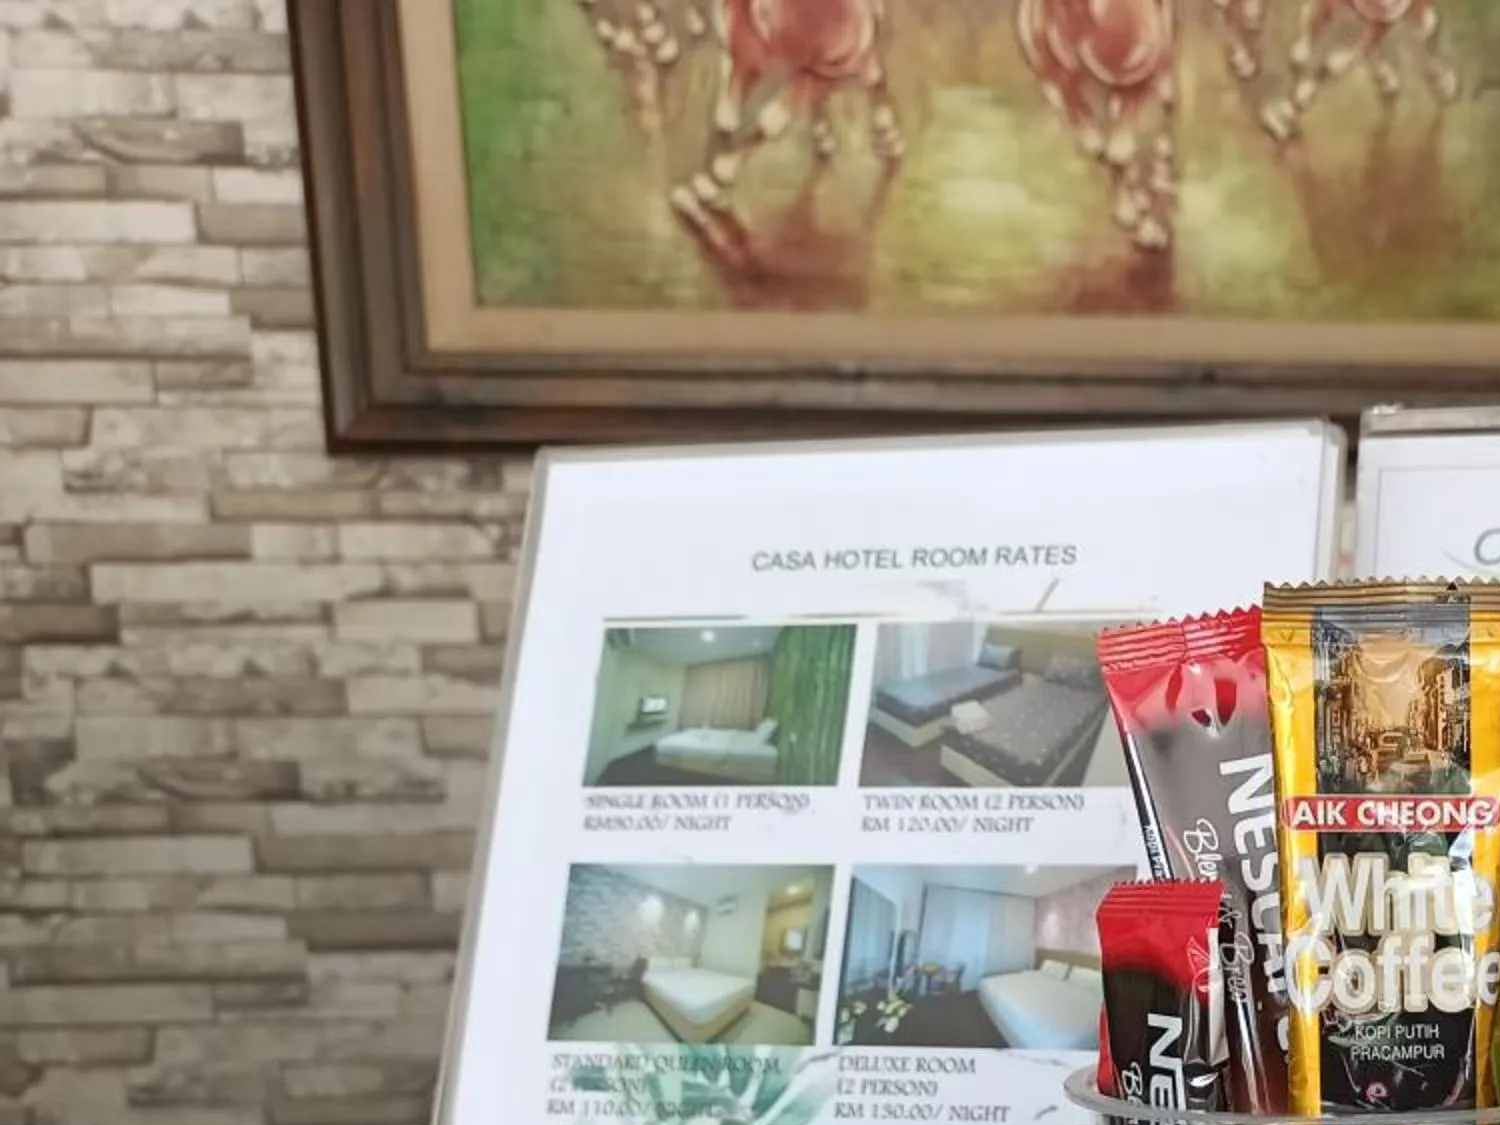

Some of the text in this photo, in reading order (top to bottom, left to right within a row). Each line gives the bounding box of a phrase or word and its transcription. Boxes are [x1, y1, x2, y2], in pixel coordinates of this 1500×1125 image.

[751, 545, 1078, 572] CASA HOTEL ROOM RATES
[650, 793, 708, 810] ROOM
[863, 794, 915, 811] TWIN
[918, 794, 979, 811] ROOM
[1007, 794, 1086, 812] PERSON)
[1293, 800, 1494, 827] AIK CHEONG
[673, 815, 733, 832] NIGHT
[861, 816, 891, 832] RM
[972, 817, 1035, 833] NIGHT
[1299, 852, 1494, 935] White
[1355, 1023, 1439, 1040] KOPI PUTIH
[1350, 1043, 1446, 1061] PRACAMPUR
[551, 1053, 648, 1070] STANDARD
[838, 1055, 977, 1074] DELUXE ROOM
[859, 1079, 939, 1097] PERSON)
[547, 1099, 575, 1115] RM
[834, 1102, 865, 1119] RM
[947, 1105, 1011, 1122] NIGHT
